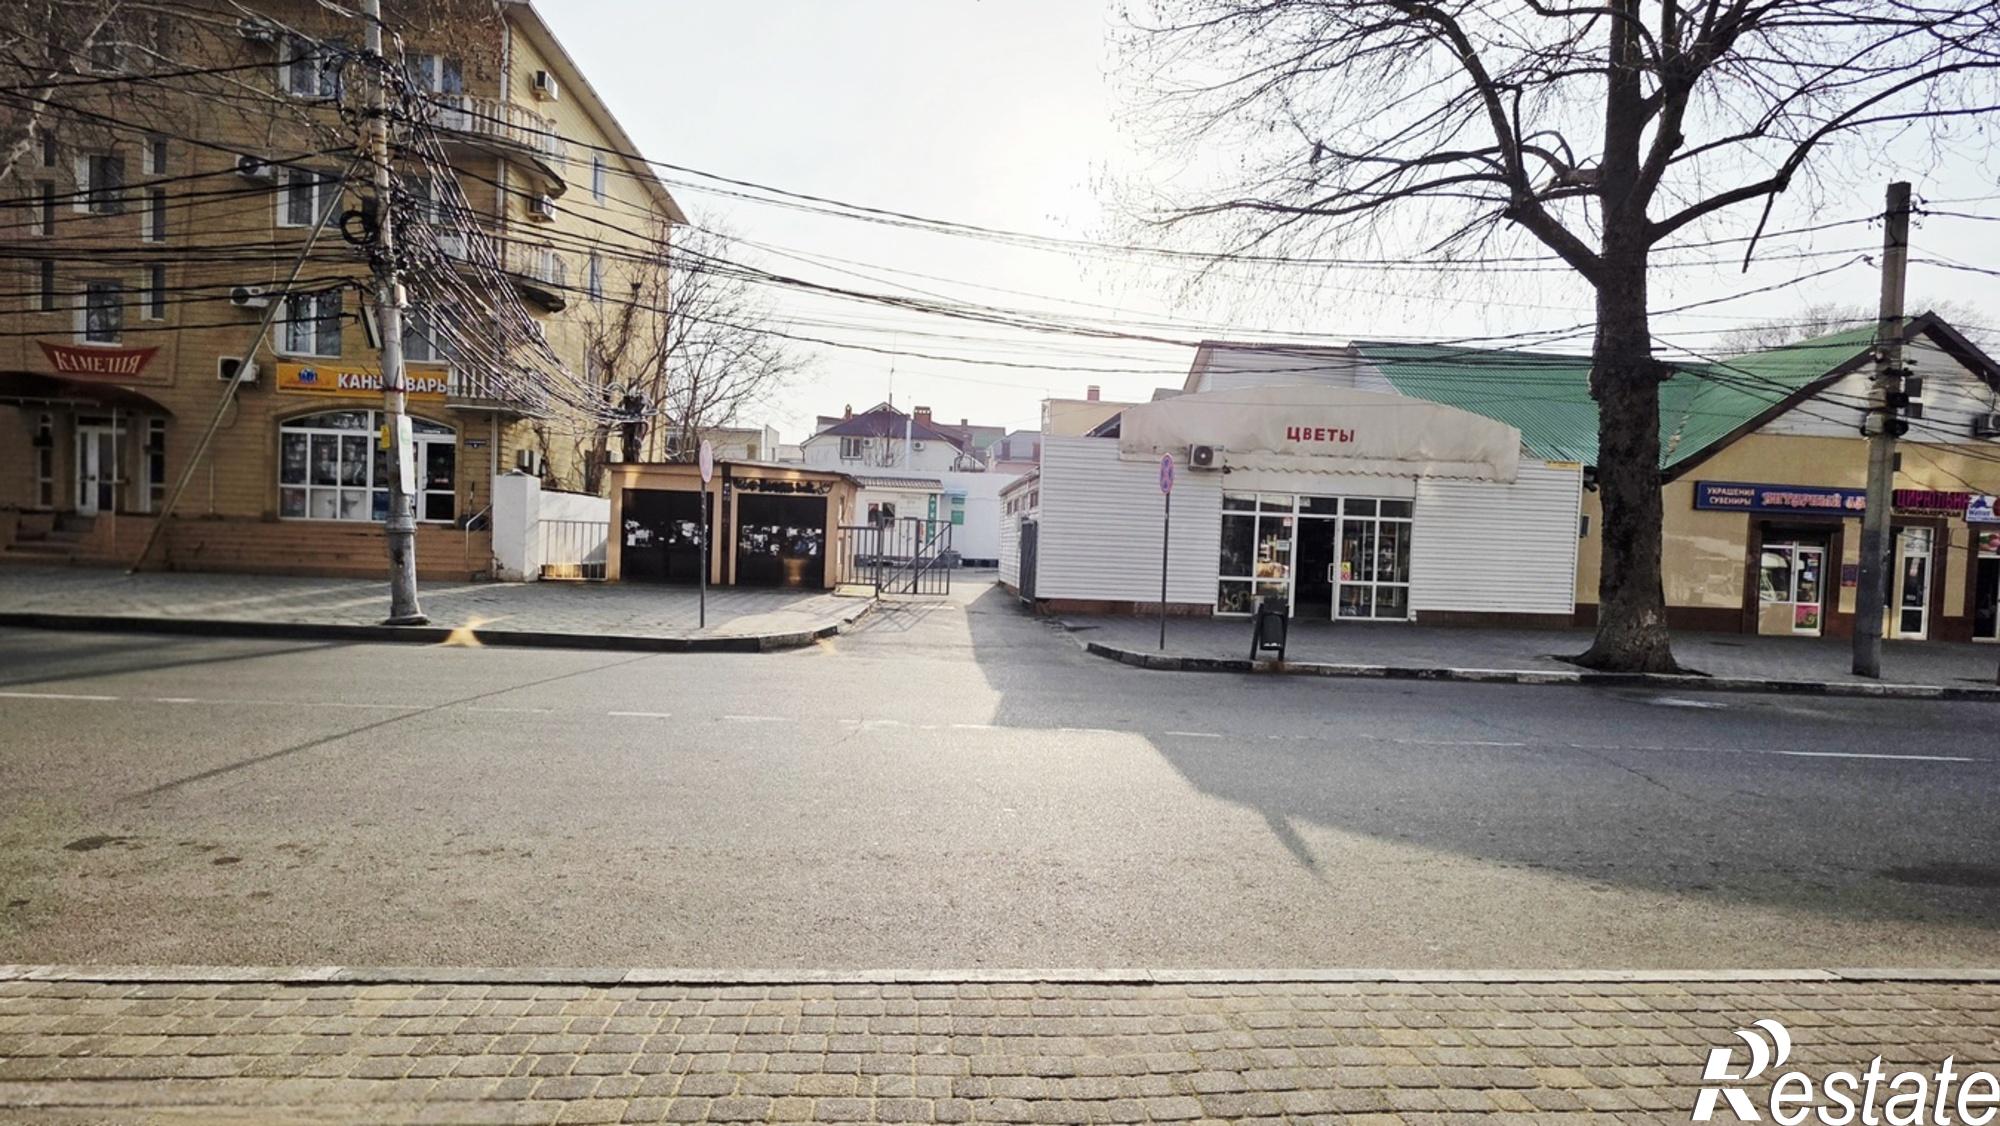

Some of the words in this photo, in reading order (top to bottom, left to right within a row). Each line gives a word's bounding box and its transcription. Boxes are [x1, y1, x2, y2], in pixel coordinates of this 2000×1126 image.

[53, 350, 142, 374] КАМЕЛИЯ
[337, 373, 448, 394] КАНЦВАРЫ
[1286, 426, 1355, 443] ЦВЕТЫ
[1707, 487, 1755, 497] УКРАШЕНИЯ
[1709, 496, 1752, 506] СУВЕНИРЫ
